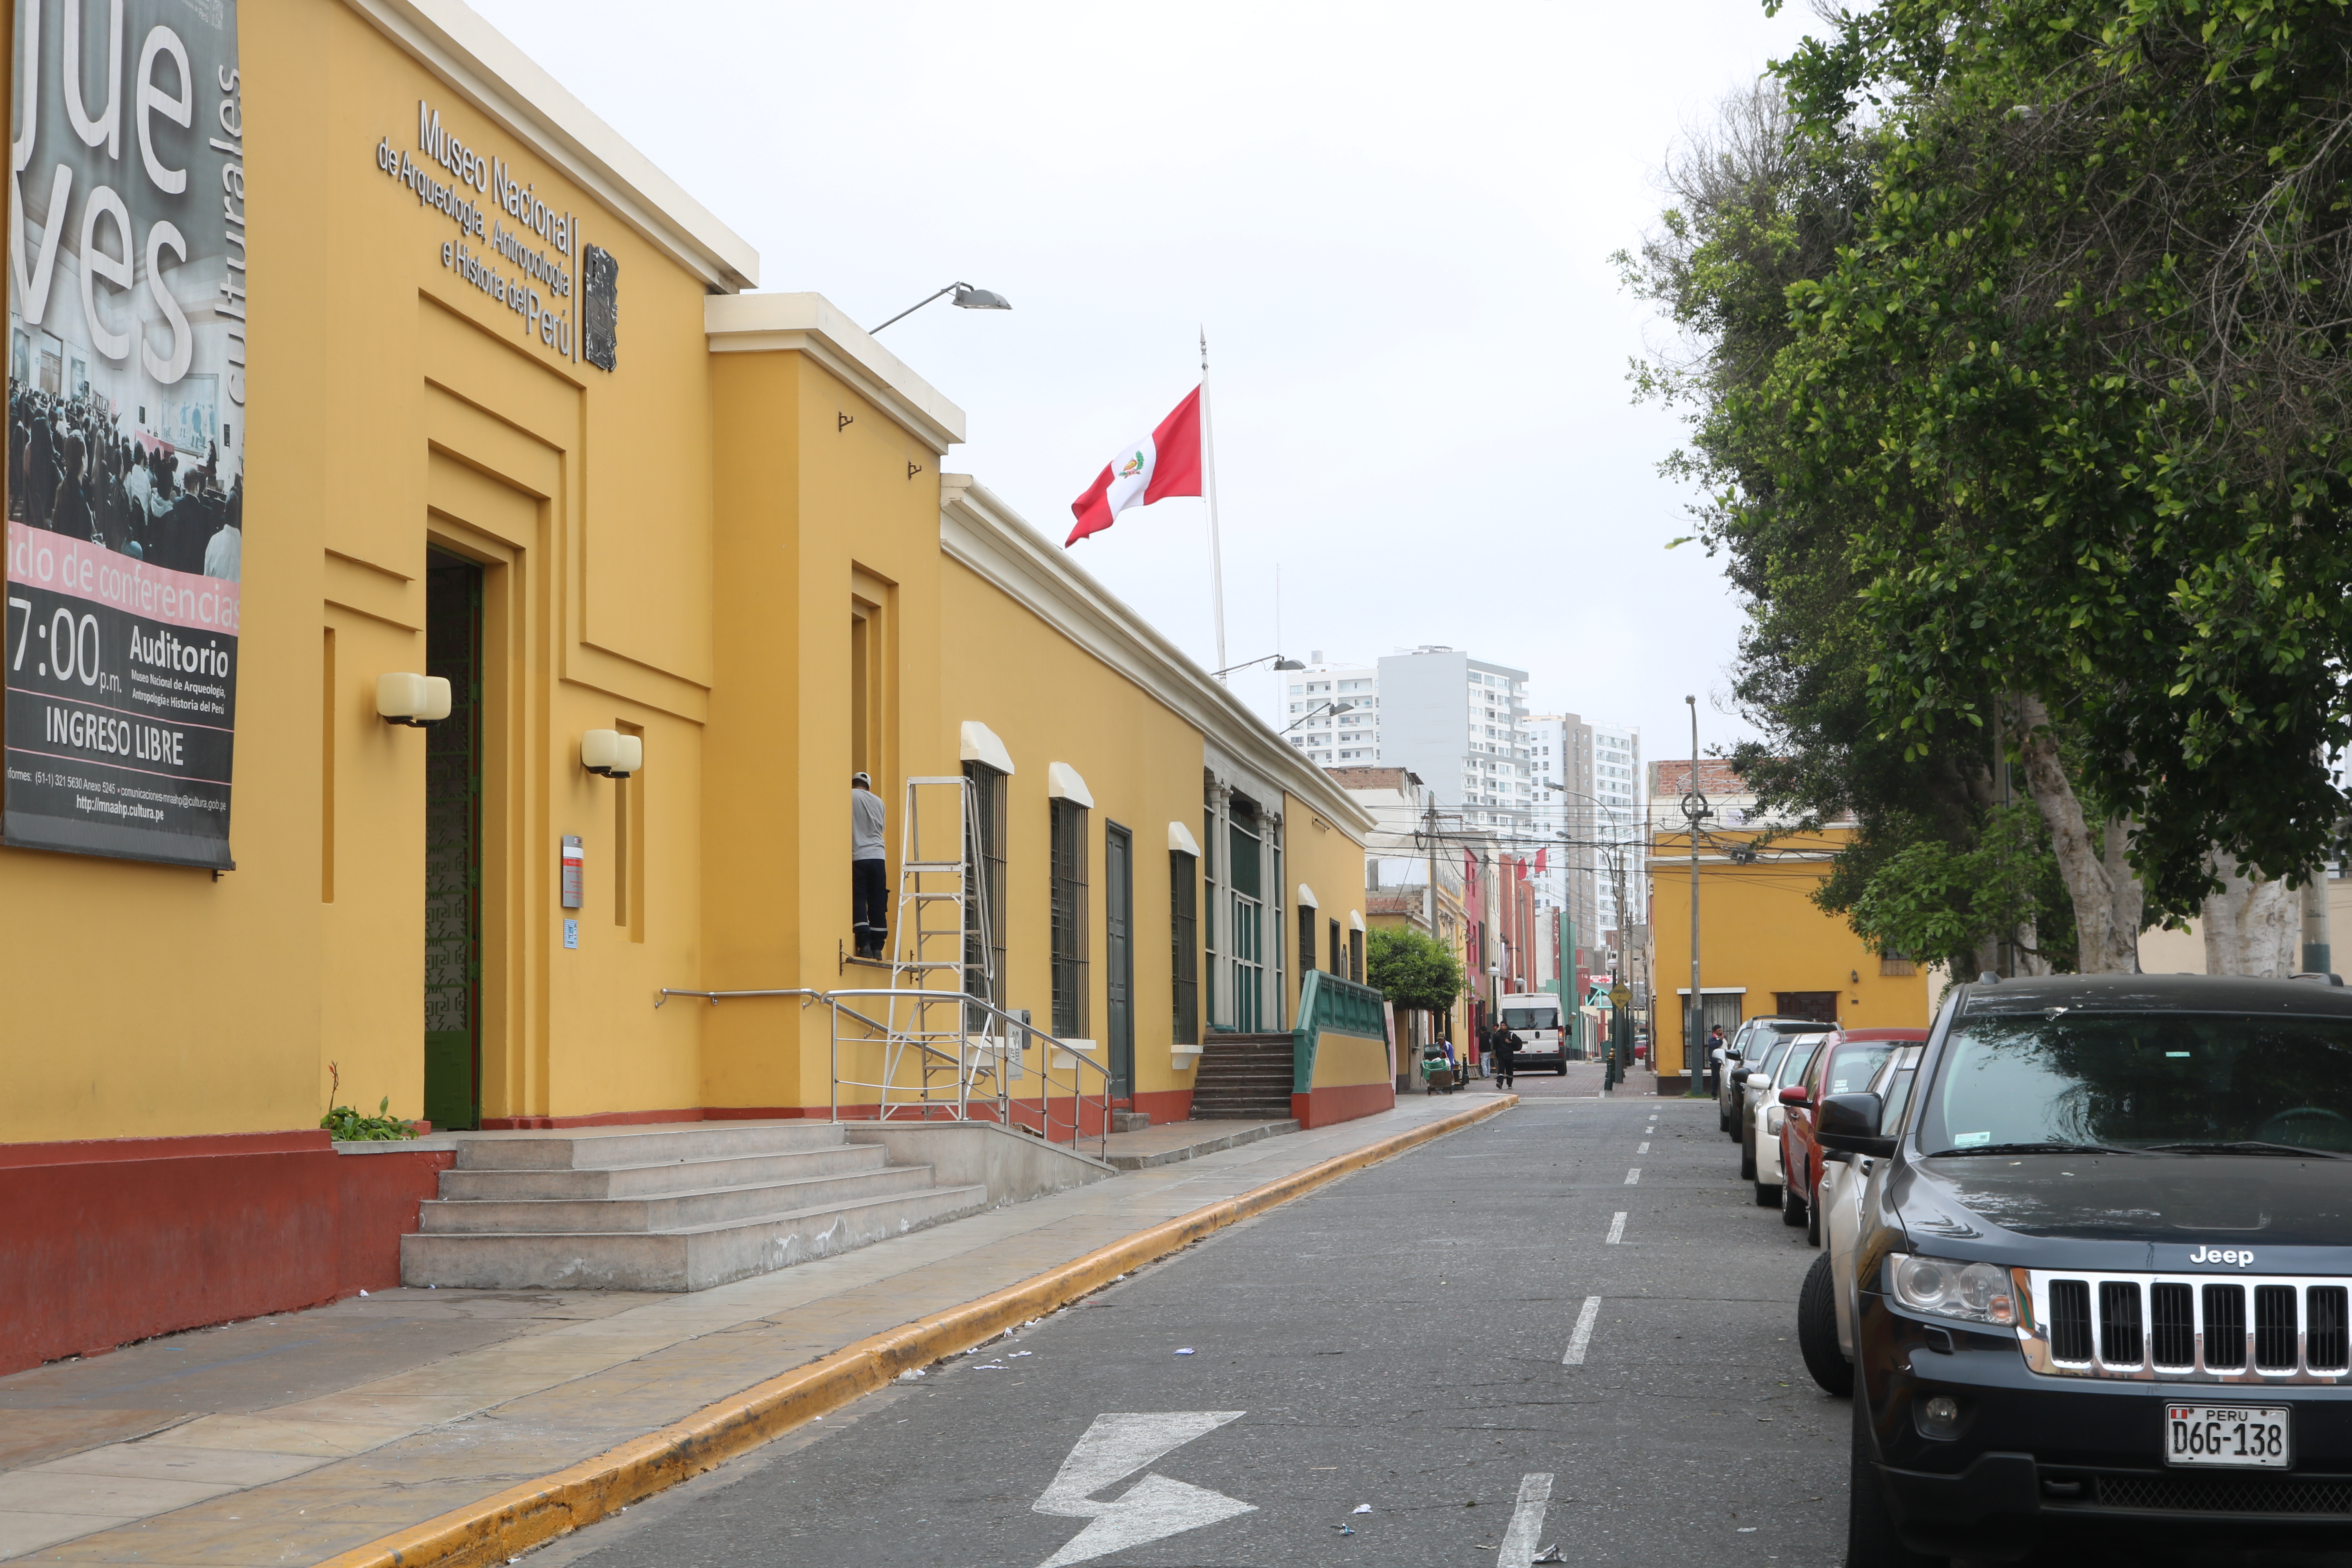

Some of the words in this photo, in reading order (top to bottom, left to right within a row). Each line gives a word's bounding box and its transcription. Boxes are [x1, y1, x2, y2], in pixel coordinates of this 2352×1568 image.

[419, 100, 486, 193] Museo
[492, 156, 570, 256] Nacional
[210, 64, 245, 404] culturales
[377, 136, 398, 175] de
[398, 151, 486, 245] Arqueología,
[491, 220, 570, 297] Antropología
[441, 242, 452, 267] e
[454, 240, 505, 301] Historia
[507, 278, 526, 316] del
[526, 288, 570, 356] Perú
[8, 527, 53, 581] iclo
[63, 543, 93, 592] de
[9, 597, 99, 686] 7:00
[100, 671, 122, 694] p.m.
[130, 625, 228, 677] Auditorio
[131, 669, 149, 683] Museo
[150, 674, 172, 688] Nacional
[174, 679, 182, 690] de
[184, 681, 225, 699] Arqueología,
[132, 688, 166, 706] Antropología
[171, 697, 198, 710] Historia
[200, 701, 210, 712] del
[212, 703, 224, 714] Perú
[47, 706, 130, 755] INGRESO
[136, 724, 183, 765] LIBRE
[7, 767, 32, 782] formes:
[35, 771, 54, 788] (51-1)
[55, 774, 66, 786] 321
[67, 776, 82, 789] 5630
[83, 779, 101, 792] Anexo
[102, 782, 115, 794] 5245
[76, 794, 164, 822] http://mnaahp.cultura.pe
[2190, 1246, 2254, 1268] Jeep
[2172, 1421, 2282, 1457] D6G-138
[2207, 1410, 2247, 1421] PERU
